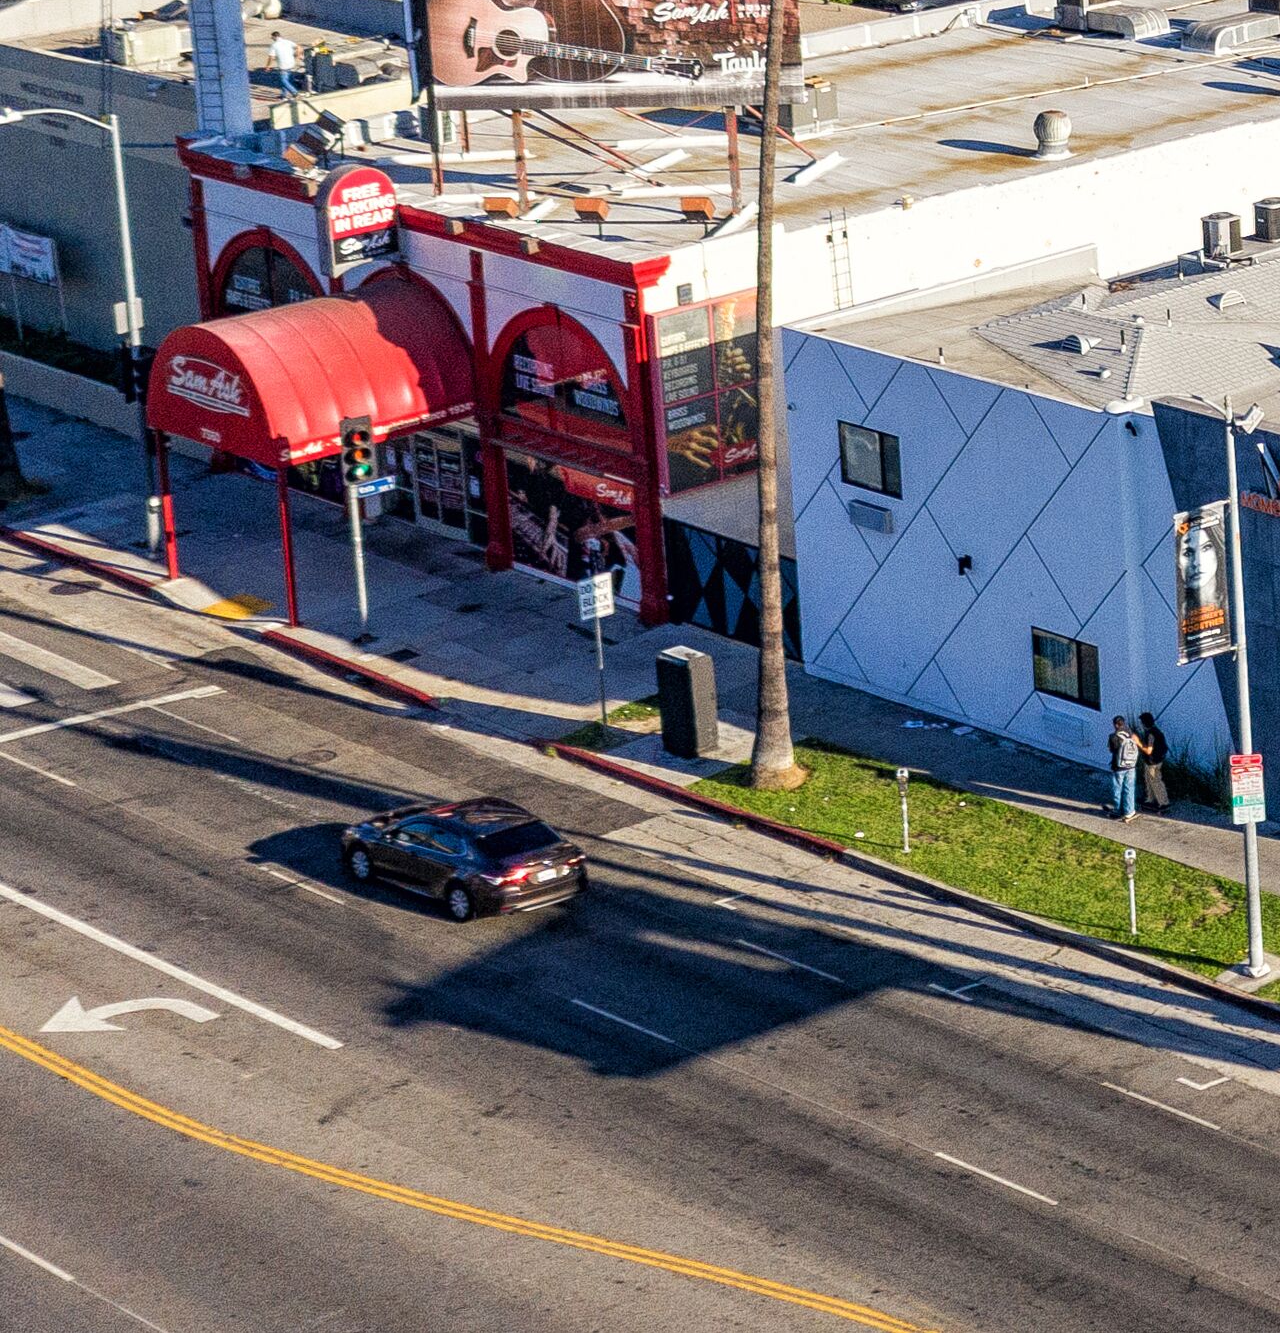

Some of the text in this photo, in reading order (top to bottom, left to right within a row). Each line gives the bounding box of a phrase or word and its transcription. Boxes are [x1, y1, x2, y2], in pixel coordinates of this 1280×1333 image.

[341, 182, 380, 203] FREE
[330, 193, 396, 220] PARKING
[334, 208, 394, 233] IN REAR
[170, 355, 208, 394] Sam
[207, 369, 243, 405] Ash
[583, 593, 610, 607] BLOCK
[1182, 617, 1225, 634] TOGETHER
